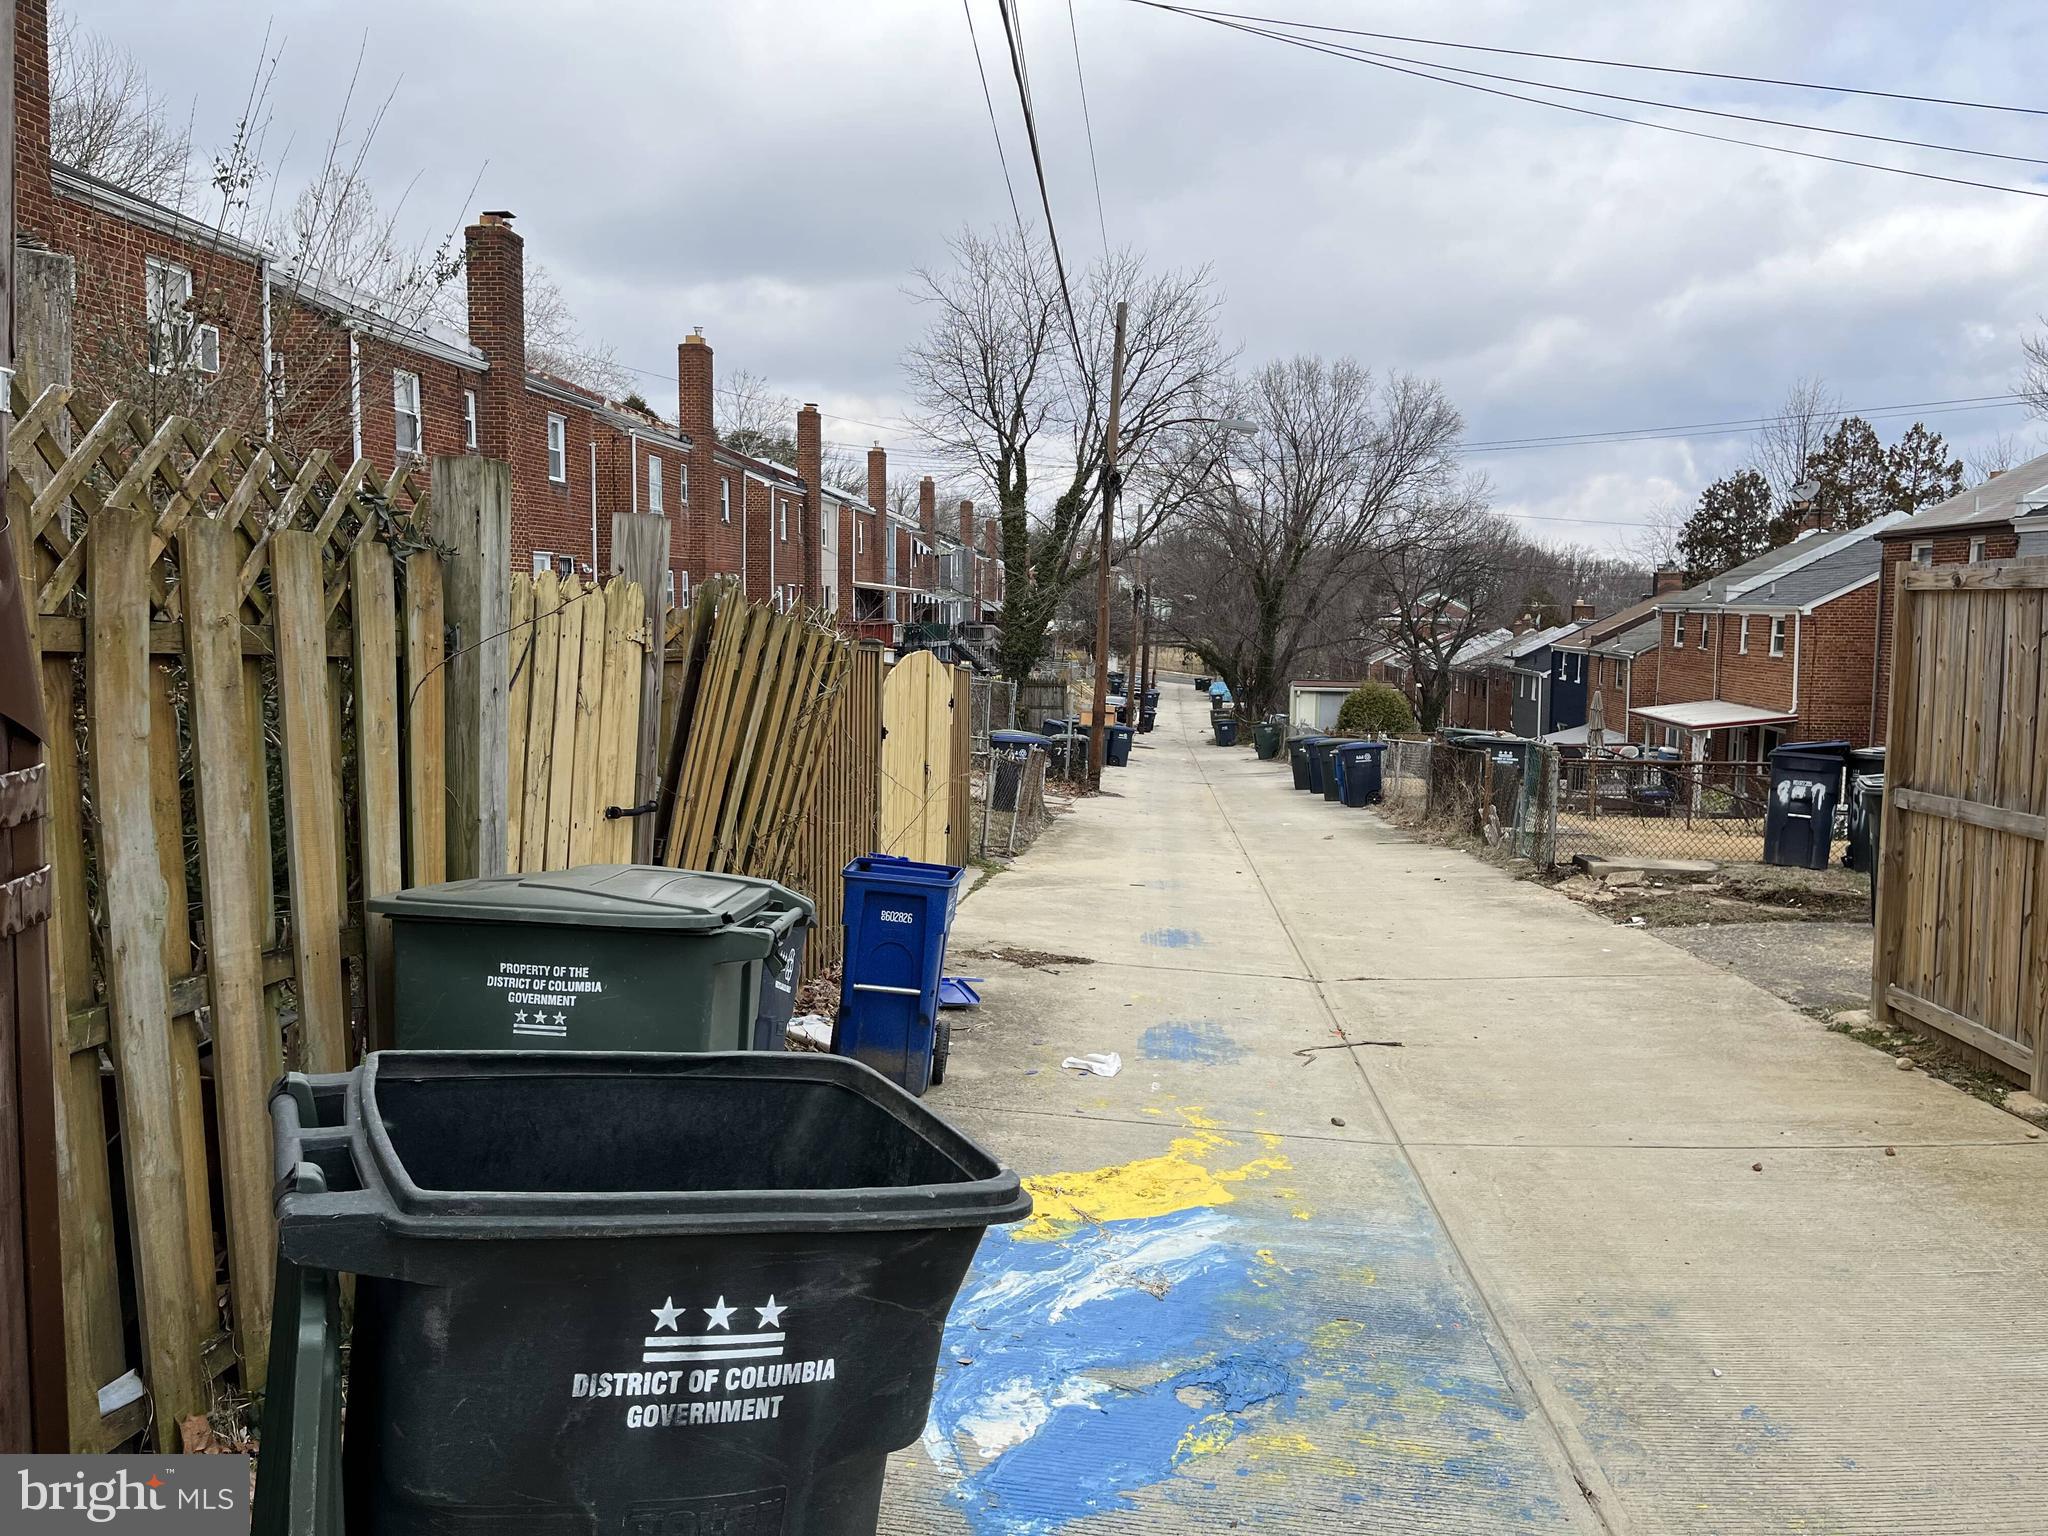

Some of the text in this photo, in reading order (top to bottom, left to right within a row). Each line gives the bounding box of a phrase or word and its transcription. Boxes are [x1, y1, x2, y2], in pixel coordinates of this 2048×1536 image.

[500, 963, 589, 978] PROPERTY OF THE
[487, 976, 602, 993] DISTRICT OF COLUMBIA
[508, 992, 577, 1006] GOVERNMENT
[571, 1358, 836, 1398] DISTRICT OF COLUMBIA
[626, 1395, 784, 1429] GOVERNMENT
